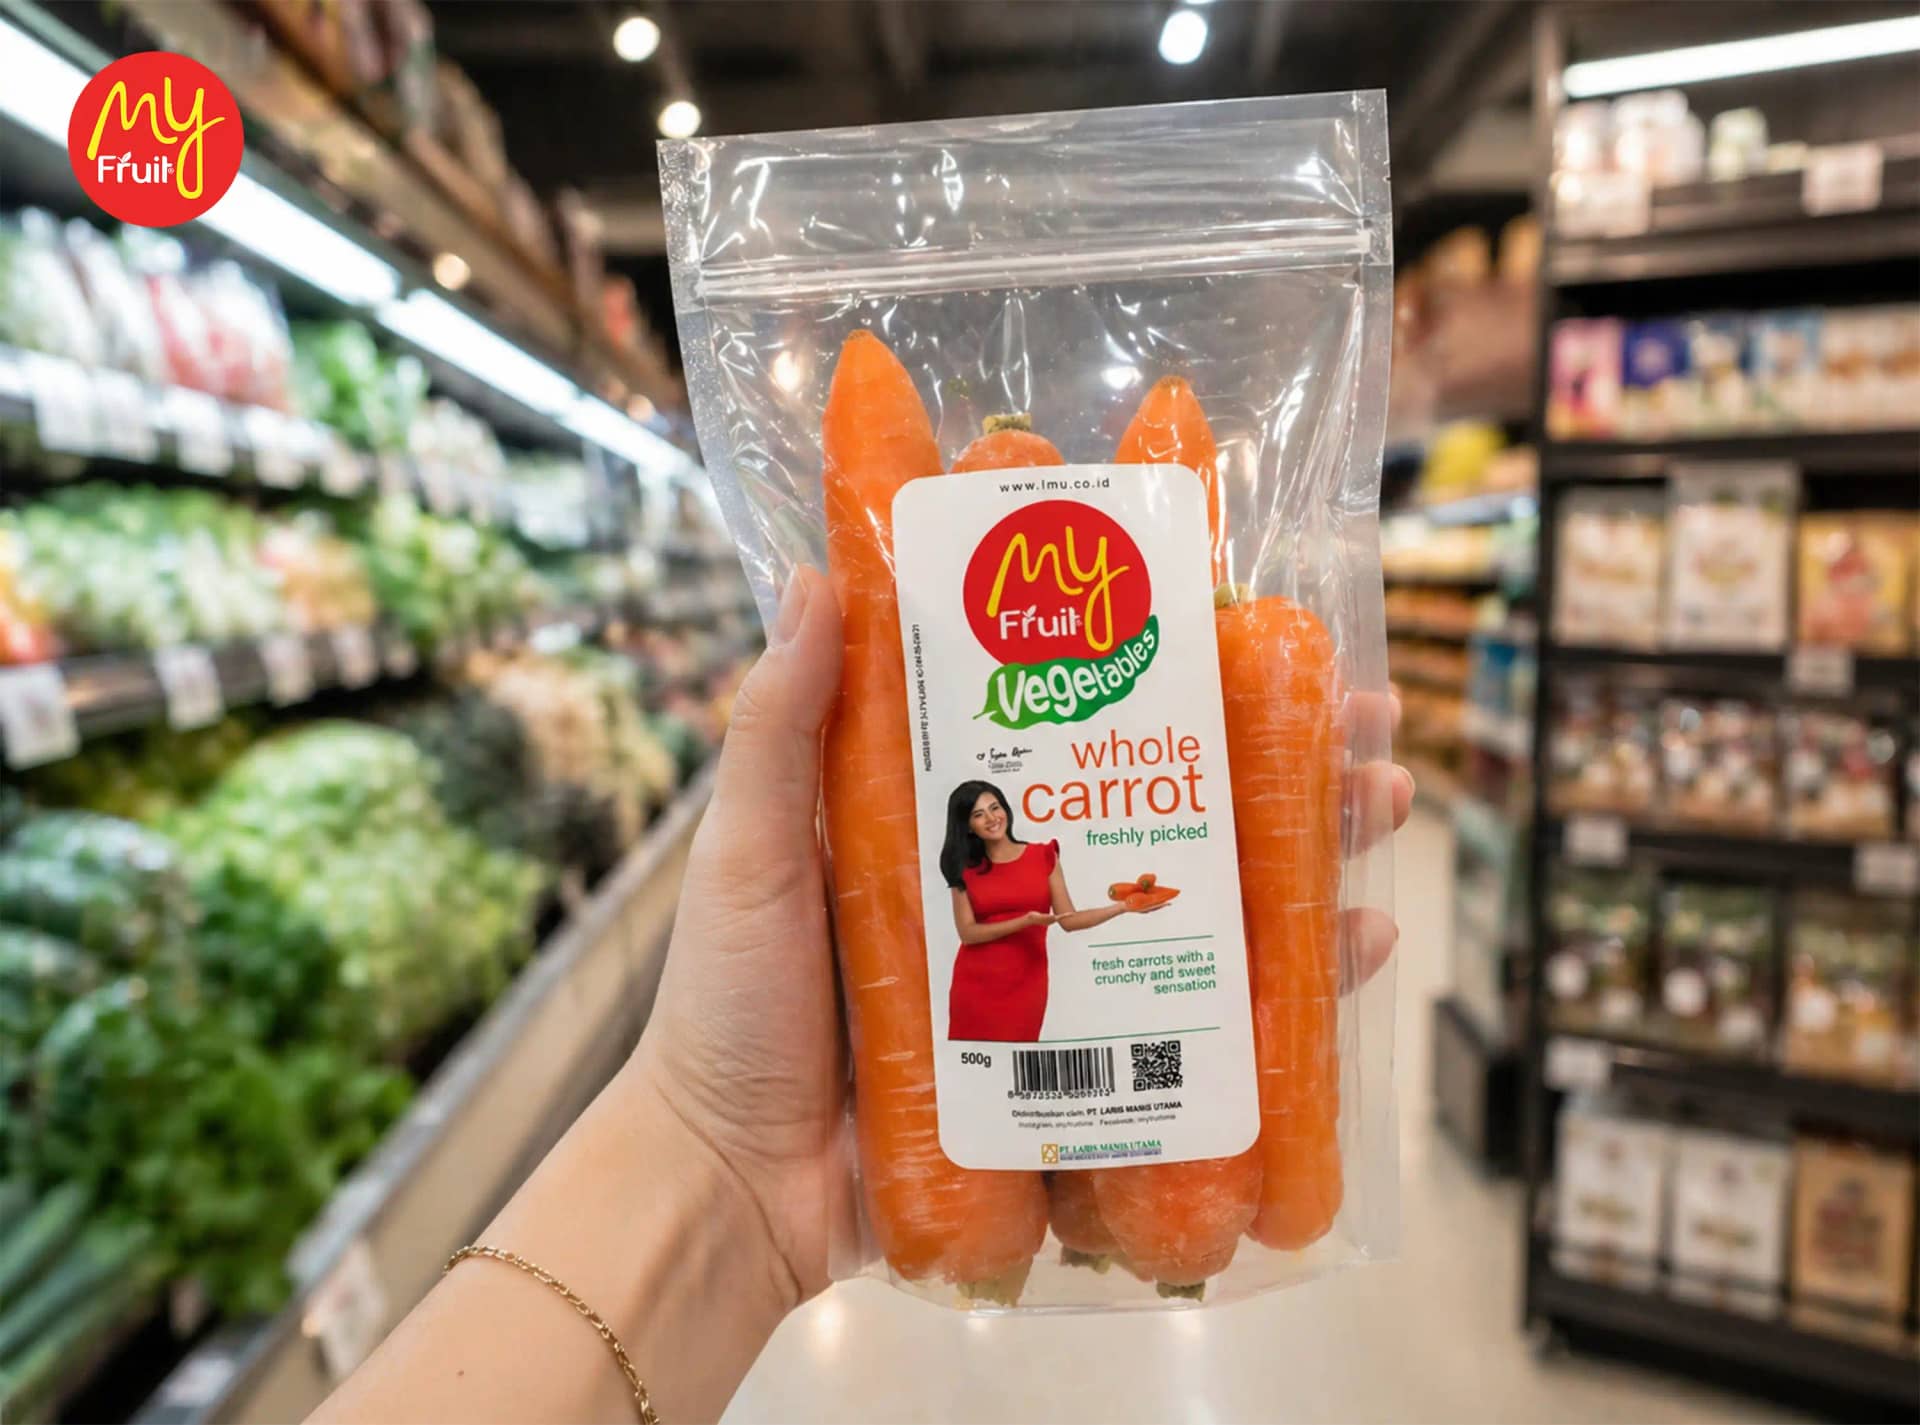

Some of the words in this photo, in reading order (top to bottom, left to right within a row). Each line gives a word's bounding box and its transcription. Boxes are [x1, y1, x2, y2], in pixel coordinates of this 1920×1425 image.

[999, 477, 1110, 493] www.lmu.co.id
[986, 525, 1130, 651] My
[1000, 604, 1082, 641] Fruit
[996, 628, 1156, 723] Vegetables
[1071, 726, 1201, 770] whole
[1022, 764, 1207, 824] carrot
[1086, 827, 1145, 848] freshly
[1150, 821, 1208, 846] picked
[1092, 957, 1125, 971] fresh
[1128, 954, 1174, 969] carrots
[1176, 949, 1204, 963] with
[1206, 951, 1215, 961] a
[1095, 970, 1147, 985] crunchy
[1150, 967, 1174, 981] and
[1178, 964, 1216, 978] sweet
[1153, 978, 1217, 995] sensation
[961, 1052, 992, 1068] 500g
[1153, 1101, 1182, 1111] UTAMA
[1129, 1139, 1162, 1149] UTAMA
